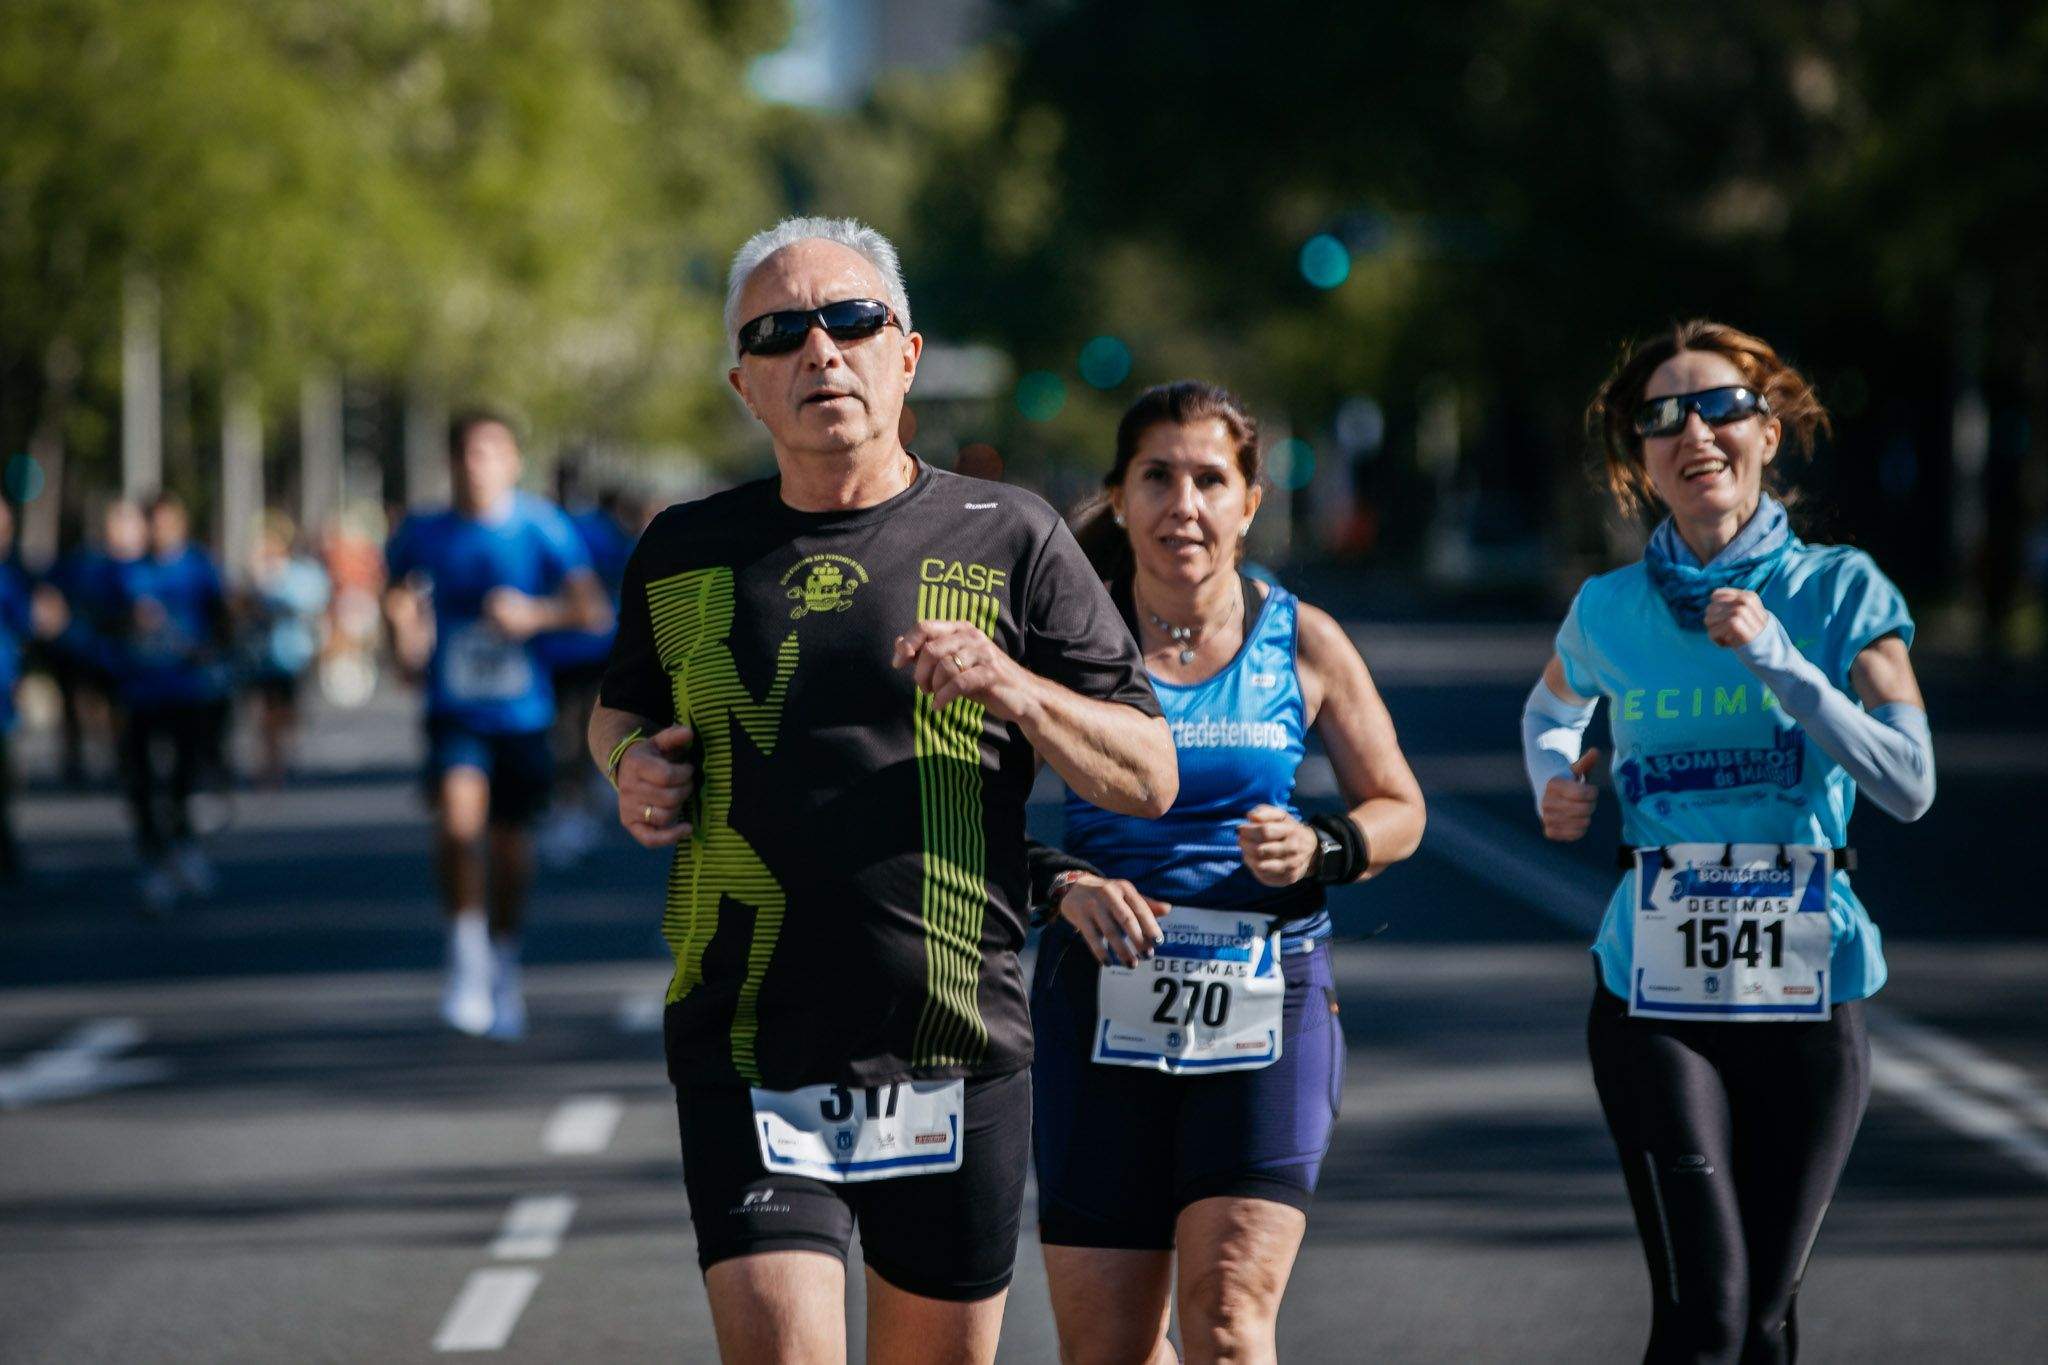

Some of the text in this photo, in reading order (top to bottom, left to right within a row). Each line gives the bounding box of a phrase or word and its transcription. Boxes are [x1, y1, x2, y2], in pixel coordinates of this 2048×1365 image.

[920, 558, 1006, 593] CASF
[1170, 715, 1288, 751] rtedeteneros
[1688, 899, 1789, 913] DECIMAS
[1677, 919, 1785, 969] 1541
[1154, 959, 1248, 977] DECIMAS
[1152, 977, 1230, 1027] 270
[820, 1082, 899, 1123] 317
